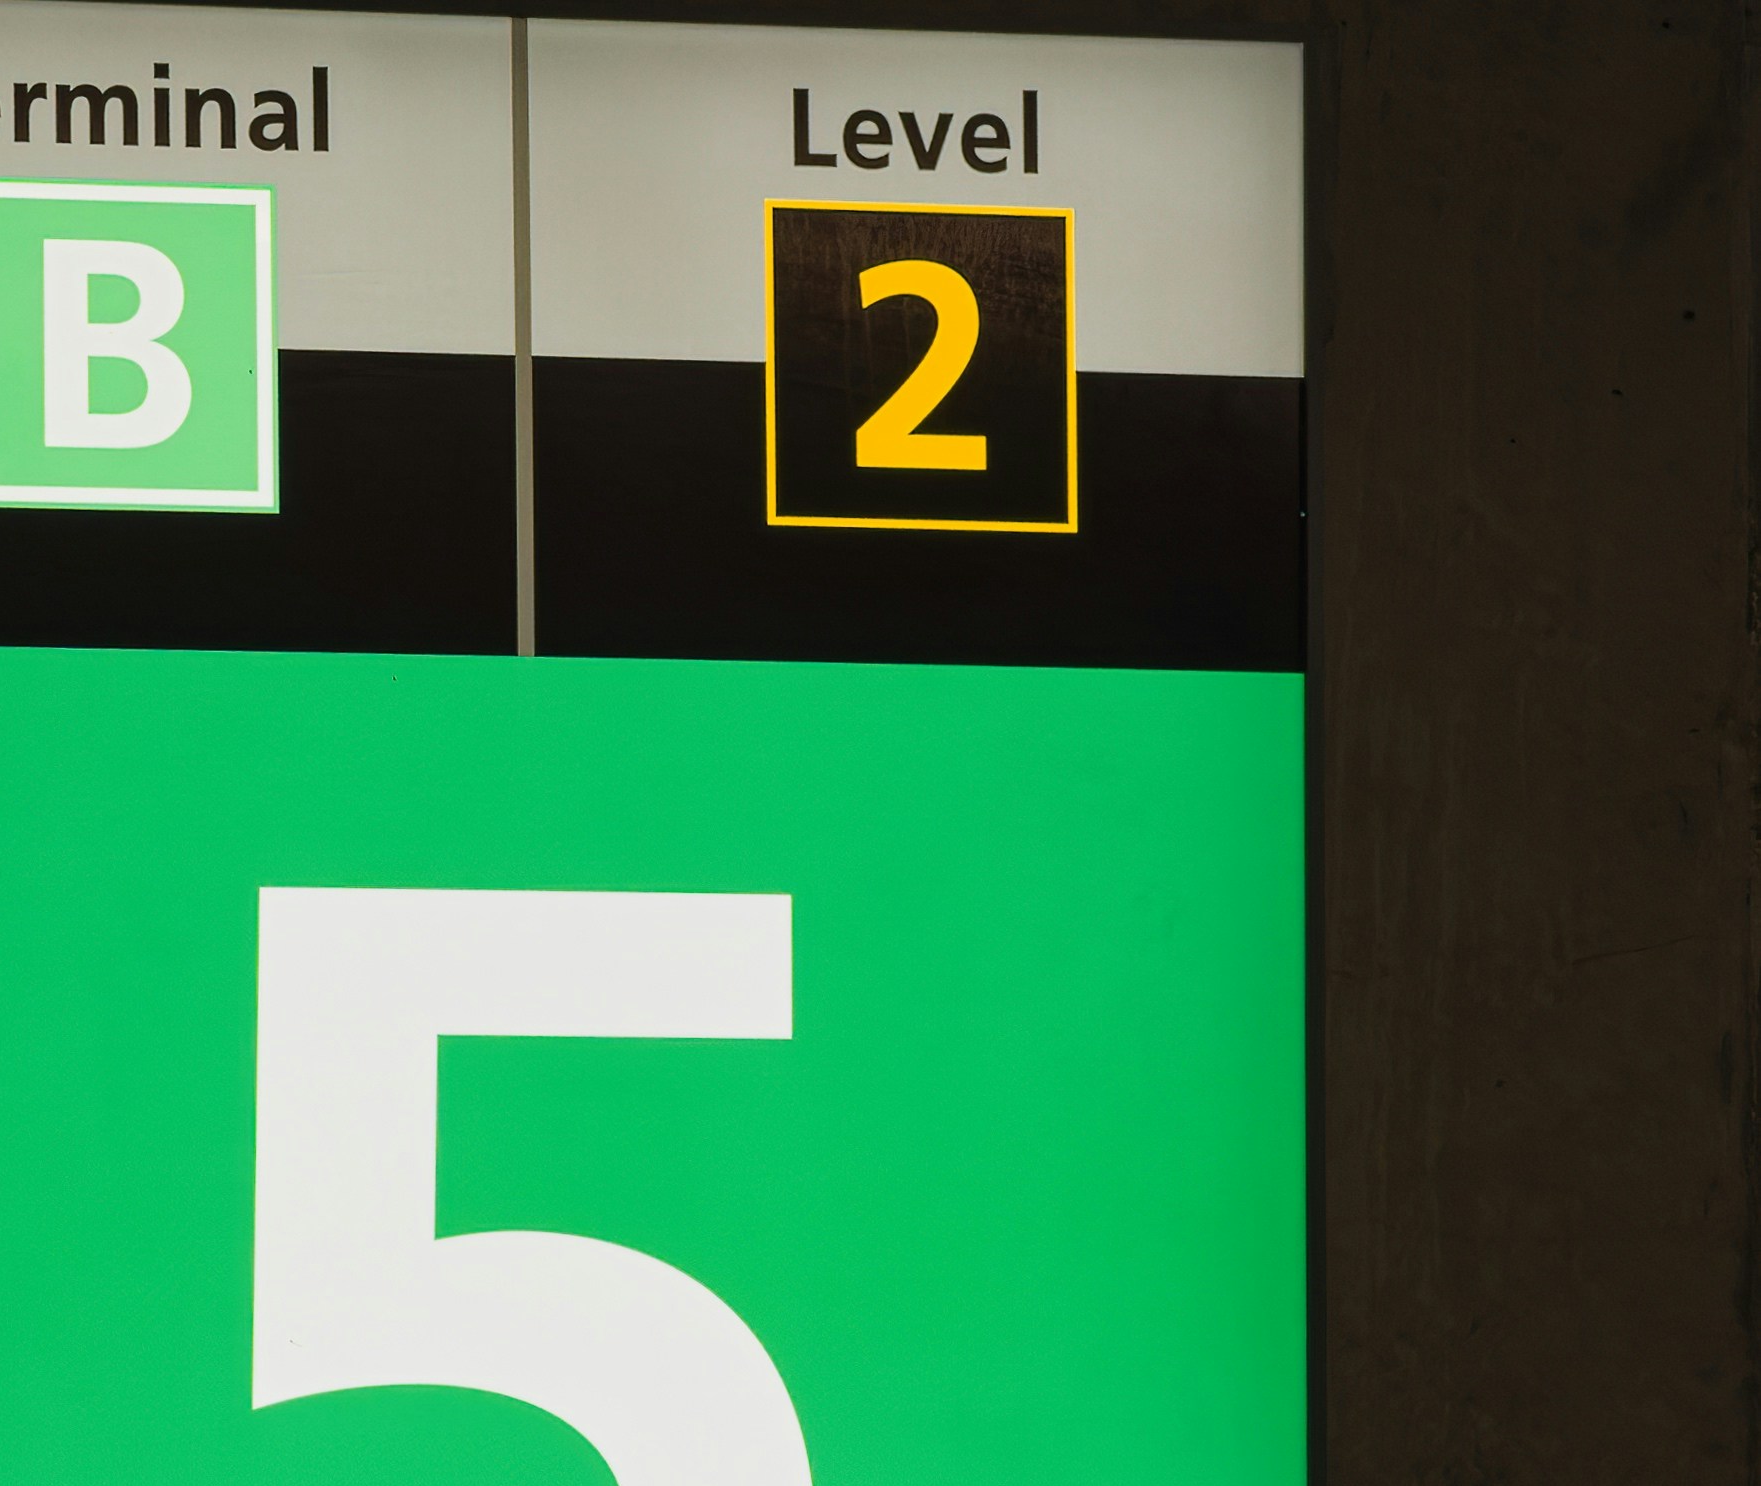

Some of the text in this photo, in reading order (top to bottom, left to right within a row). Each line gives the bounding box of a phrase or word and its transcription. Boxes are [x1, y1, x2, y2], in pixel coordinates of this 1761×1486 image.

[792, 88, 1040, 174] Level
[42, 238, 193, 449] B
[855, 259, 987, 471] 2
